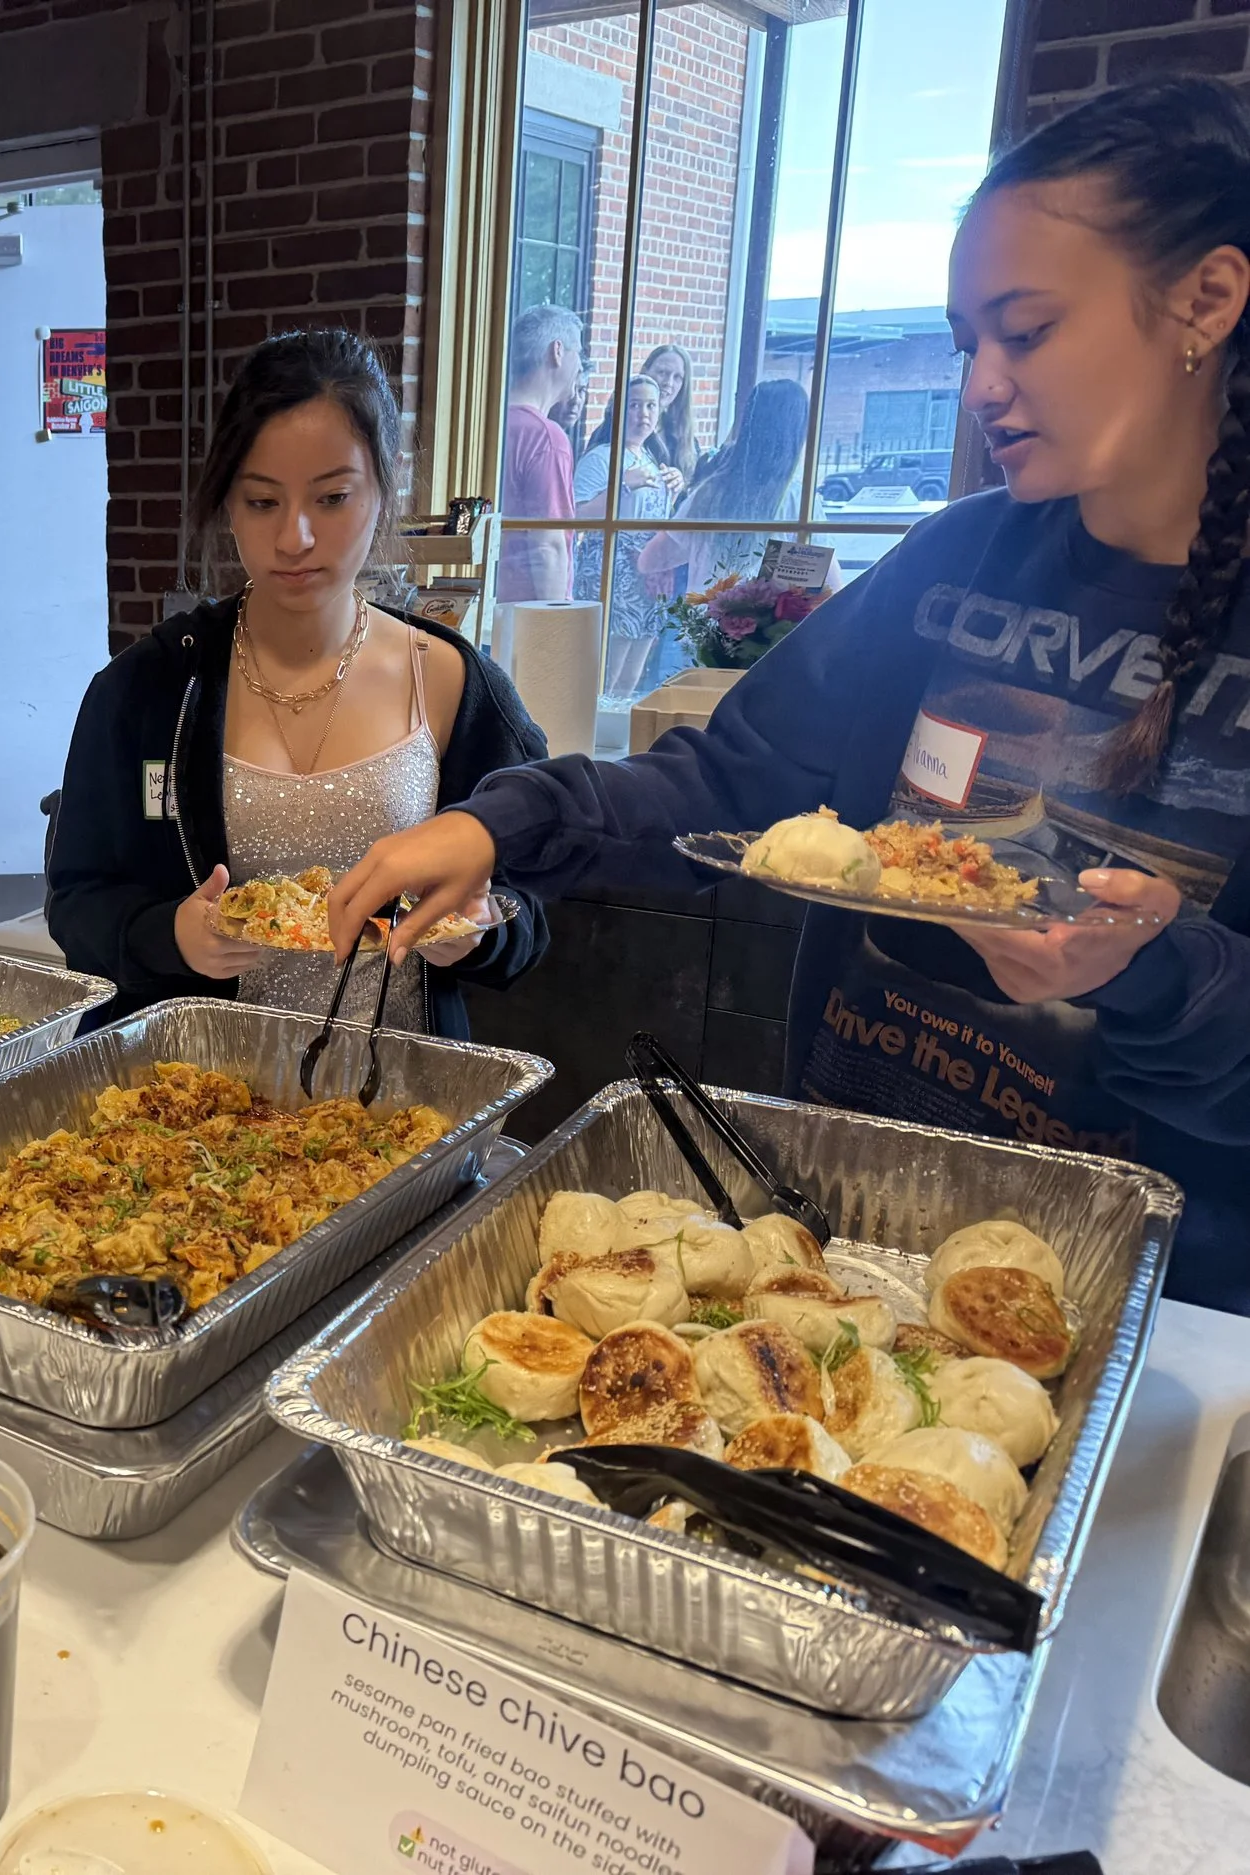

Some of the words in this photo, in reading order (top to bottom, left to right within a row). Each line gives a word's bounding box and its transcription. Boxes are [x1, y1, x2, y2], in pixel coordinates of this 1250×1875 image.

[50, 351, 85, 362] DREAMS
[62, 364, 103, 376] DENVER'S
[69, 381, 104, 396] LITTLE
[68, 398, 107, 413] SAIGON
[823, 987, 906, 1055] Drive
[911, 1031, 975, 1091] the
[884, 990, 918, 1018] You
[921, 1010, 959, 1037] owe
[961, 1024, 974, 1045] it
[976, 1033, 994, 1055] to
[999, 1043, 1055, 1096] Yourself
[342, 1613, 489, 1707] Chinese
[499, 1697, 607, 1768] chive
[619, 1748, 706, 1820] bao
[330, 1688, 432, 1754] mushroom,
[436, 1743, 478, 1779] tofu,
[482, 1770, 526, 1801] and
[527, 1793, 592, 1838] saifun
[343, 1672, 416, 1719] sesame
[417, 1712, 458, 1742] pan
[461, 1731, 507, 1767] fried
[510, 1757, 551, 1790] bao
[555, 1783, 632, 1832] stuffed
[635, 1824, 683, 1861] with
[362, 1729, 452, 1789] dumpling
[454, 1783, 516, 1821] sauce
[520, 1815, 548, 1839] on
[551, 1829, 588, 1860] the
[591, 1853, 638, 1875] sid
[417, 1851, 444, 1874] nut
[429, 1836, 457, 1860] not
